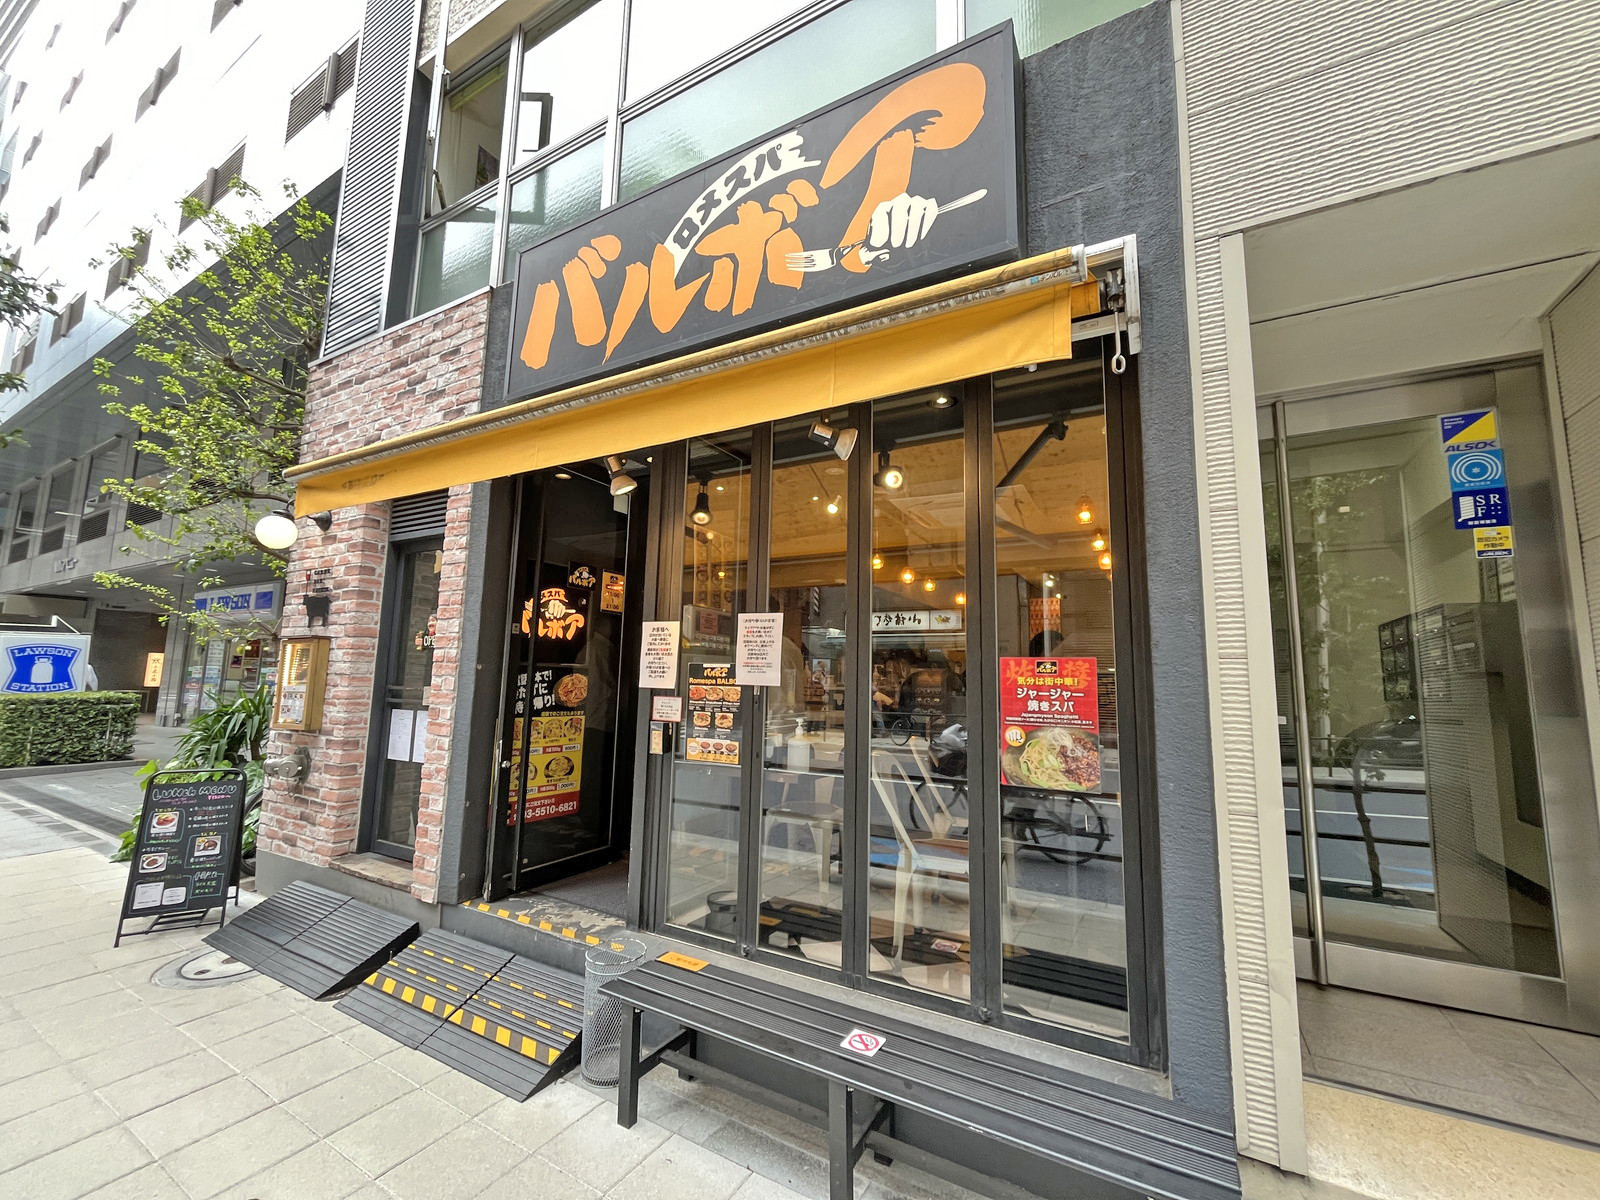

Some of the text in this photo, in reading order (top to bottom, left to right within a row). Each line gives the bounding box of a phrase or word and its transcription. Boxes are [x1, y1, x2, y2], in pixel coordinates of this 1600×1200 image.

[673, 143, 783, 248] ロメスパ
[520, 63, 986, 370] バルボア
[1445, 440, 1496, 453] ALSOK
[14, 647, 75, 658] LAWSON
[10, 681, 70, 692] STATION
[689, 677, 716, 685] Romespa
[1016, 688, 1085, 700] ジャージャー
[1027, 700, 1075, 713] 焼きスパ
[199, 785, 237, 796] MENU
